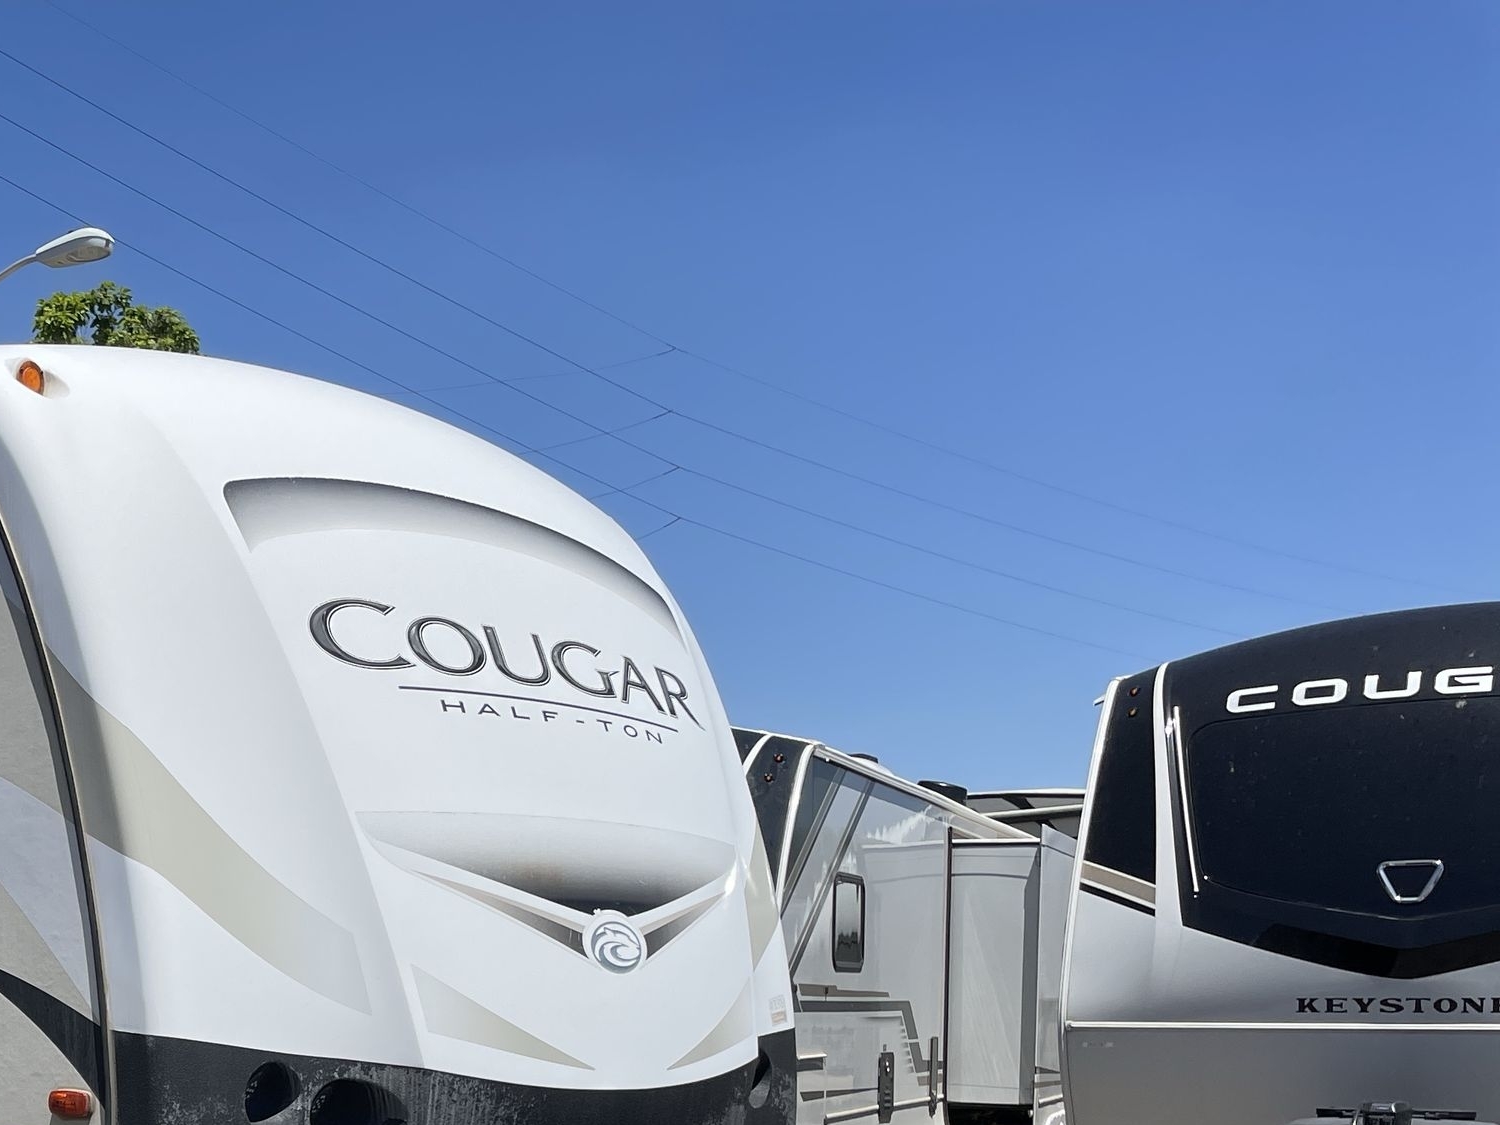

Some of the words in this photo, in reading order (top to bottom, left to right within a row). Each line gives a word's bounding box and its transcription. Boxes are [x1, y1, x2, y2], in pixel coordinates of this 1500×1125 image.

[308, 597, 705, 731] COUGAR
[1226, 666, 1494, 714] COUG
[440, 698, 664, 745] HALF-TON
